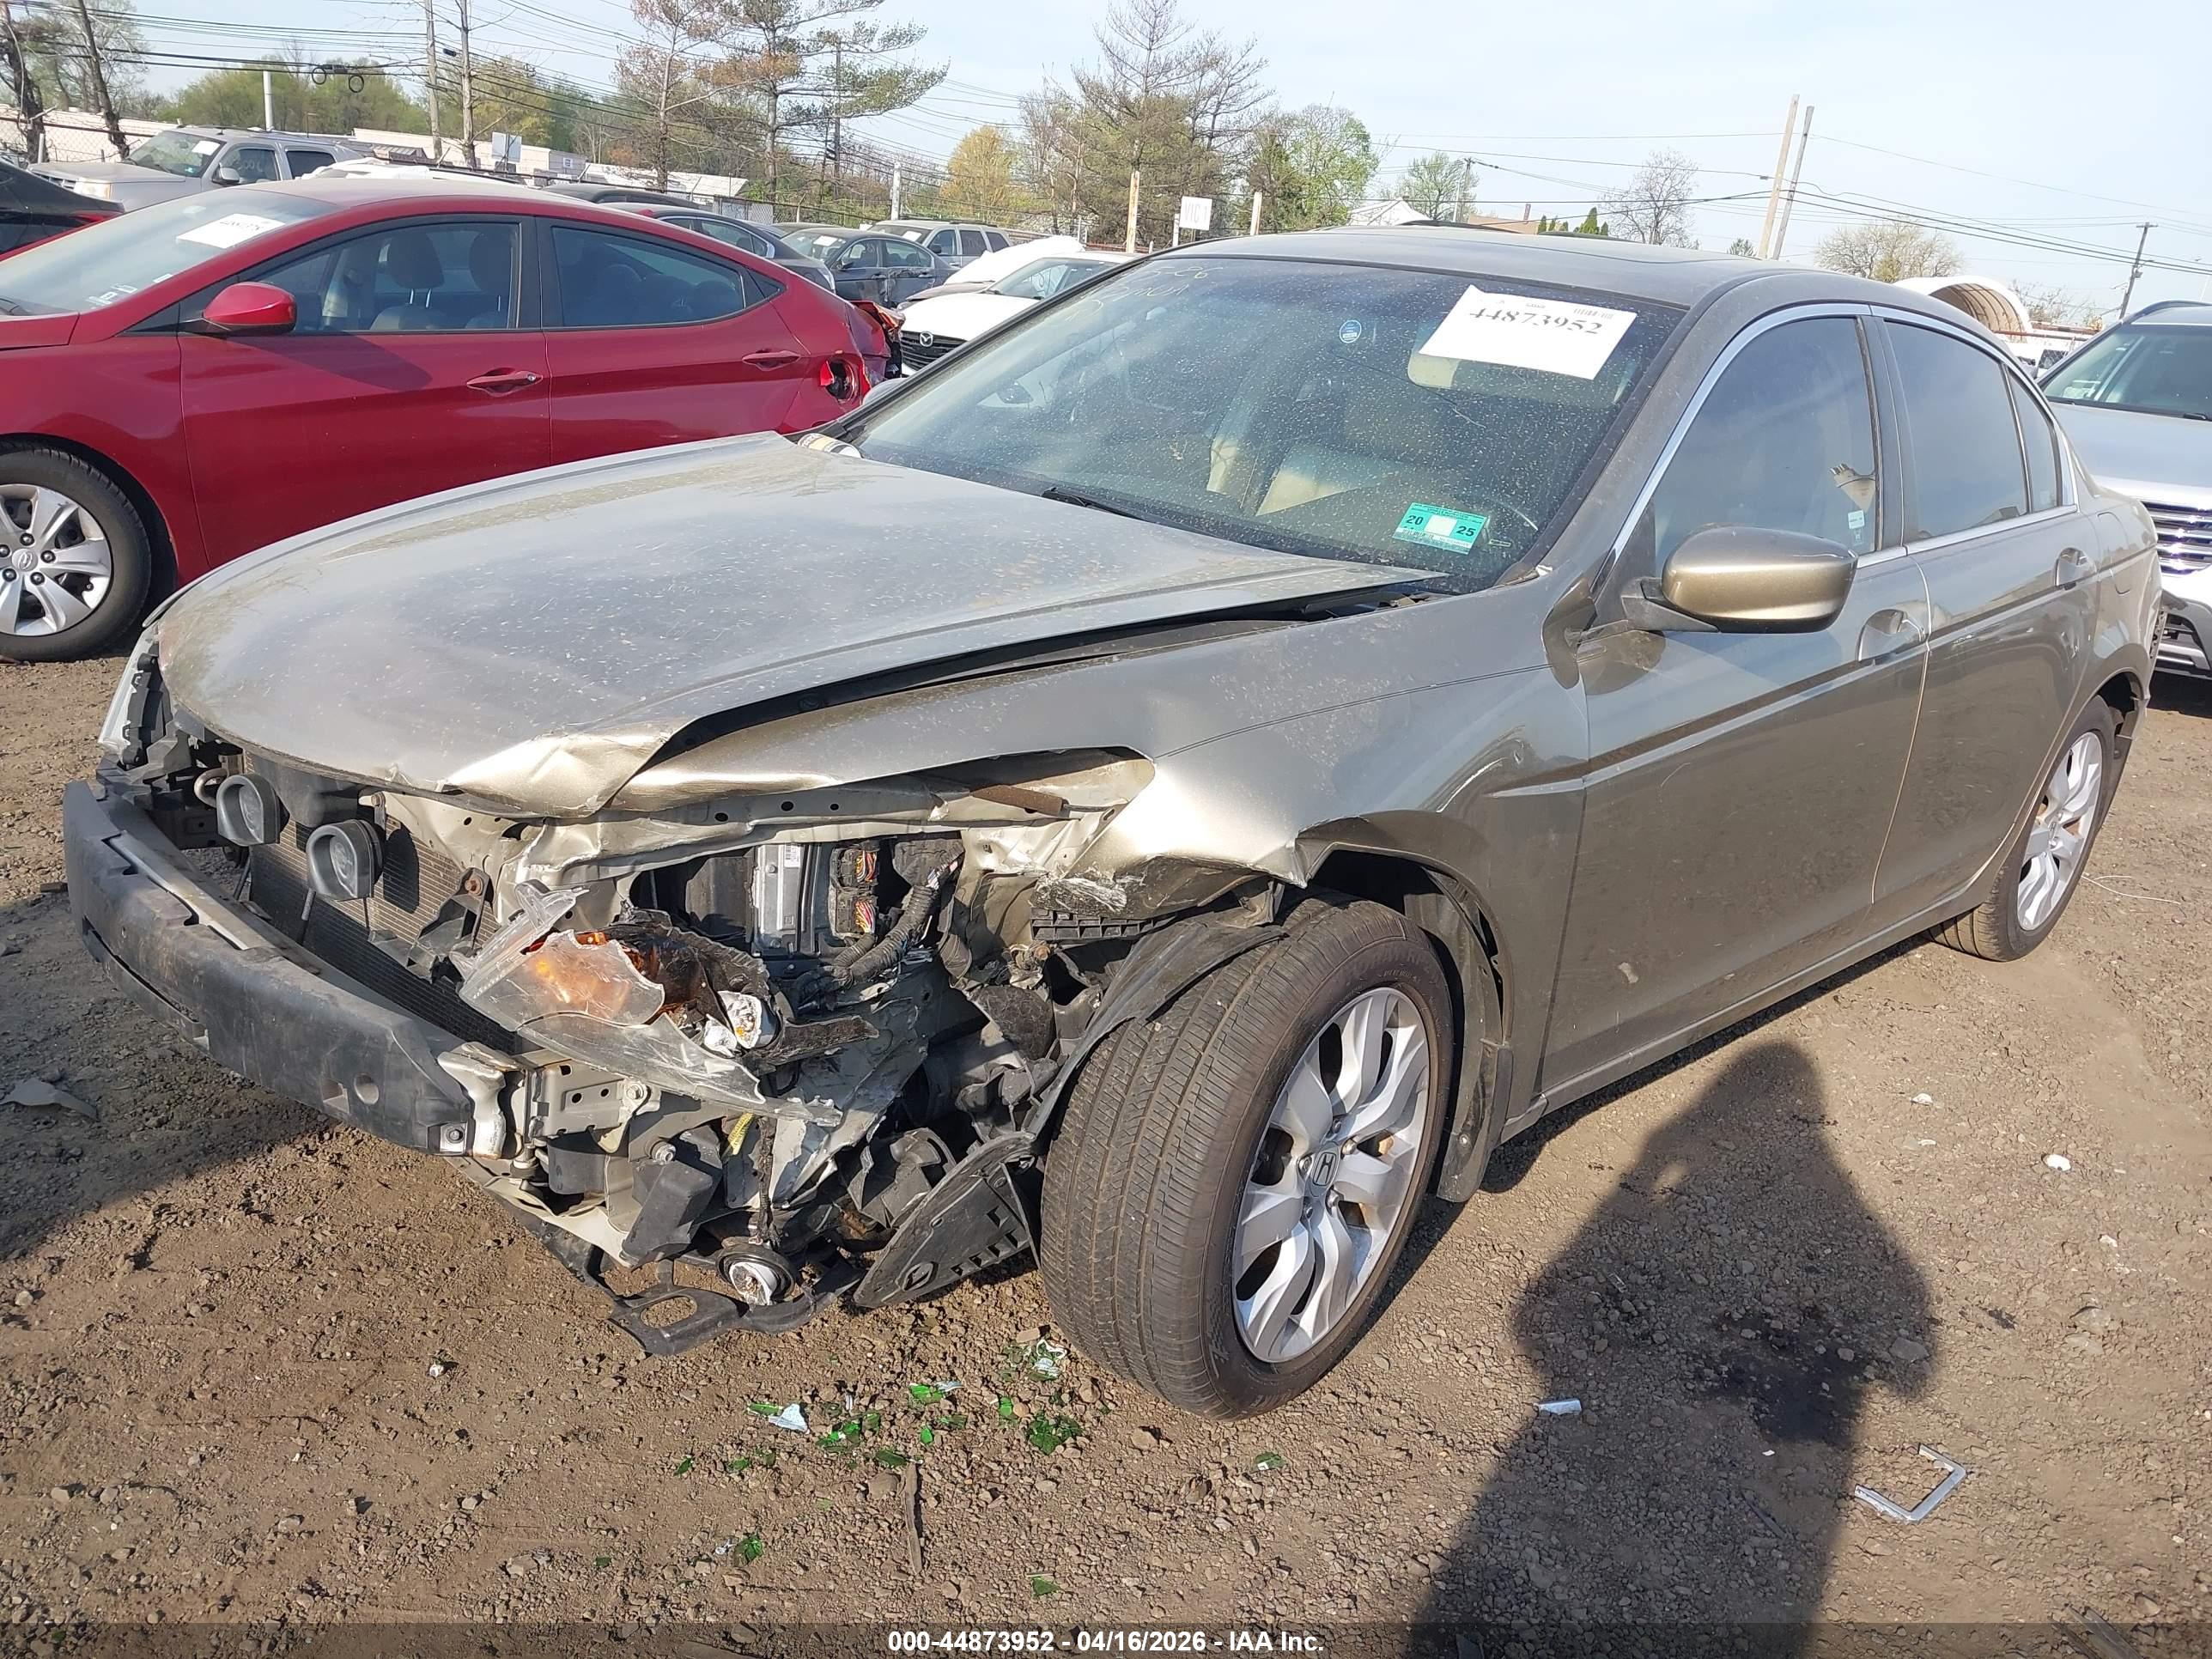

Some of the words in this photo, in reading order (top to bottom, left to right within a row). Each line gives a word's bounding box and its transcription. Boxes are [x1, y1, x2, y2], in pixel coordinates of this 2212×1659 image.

[1469, 307, 1603, 335] 44873952
[1406, 514, 1424, 526] 20
[1455, 526, 1477, 537] 25
